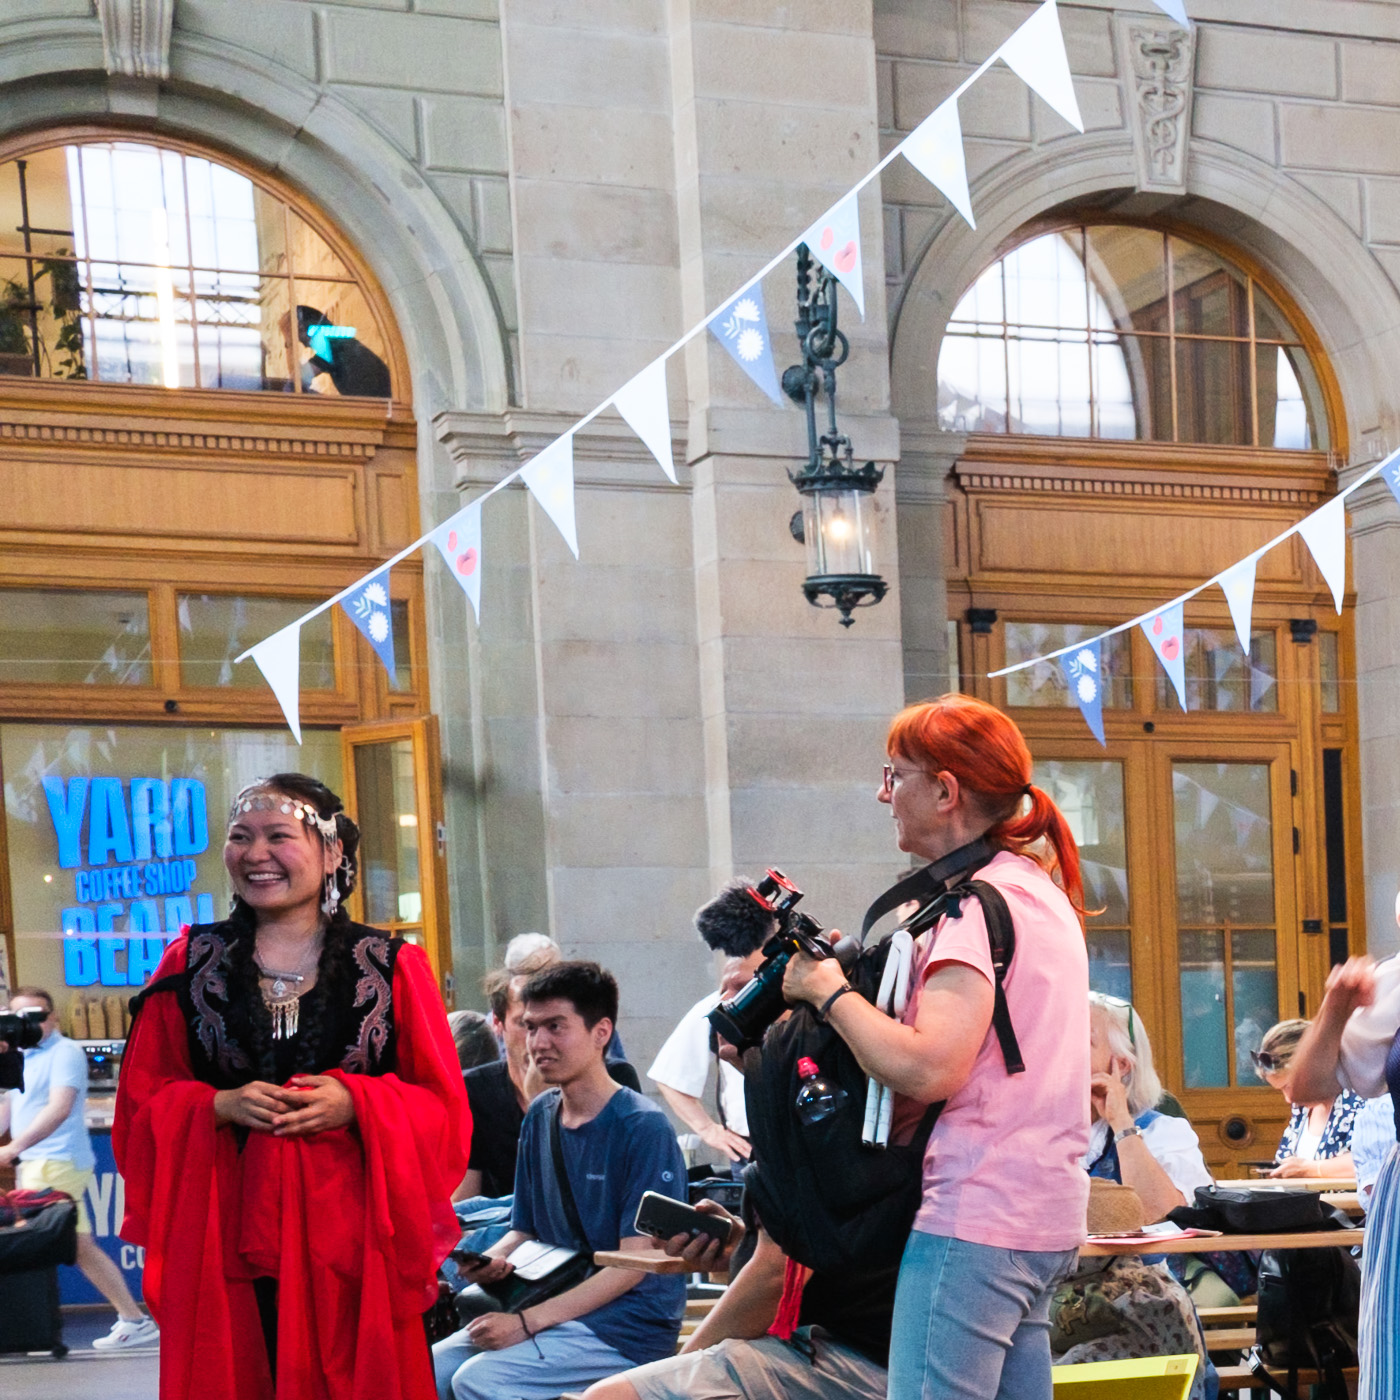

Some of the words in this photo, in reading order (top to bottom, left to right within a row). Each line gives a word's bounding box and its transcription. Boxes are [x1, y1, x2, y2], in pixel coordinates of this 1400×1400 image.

[41, 776, 209, 869] YARD
[75, 865, 143, 904] COFFEE
[143, 859, 197, 896] SHOP
